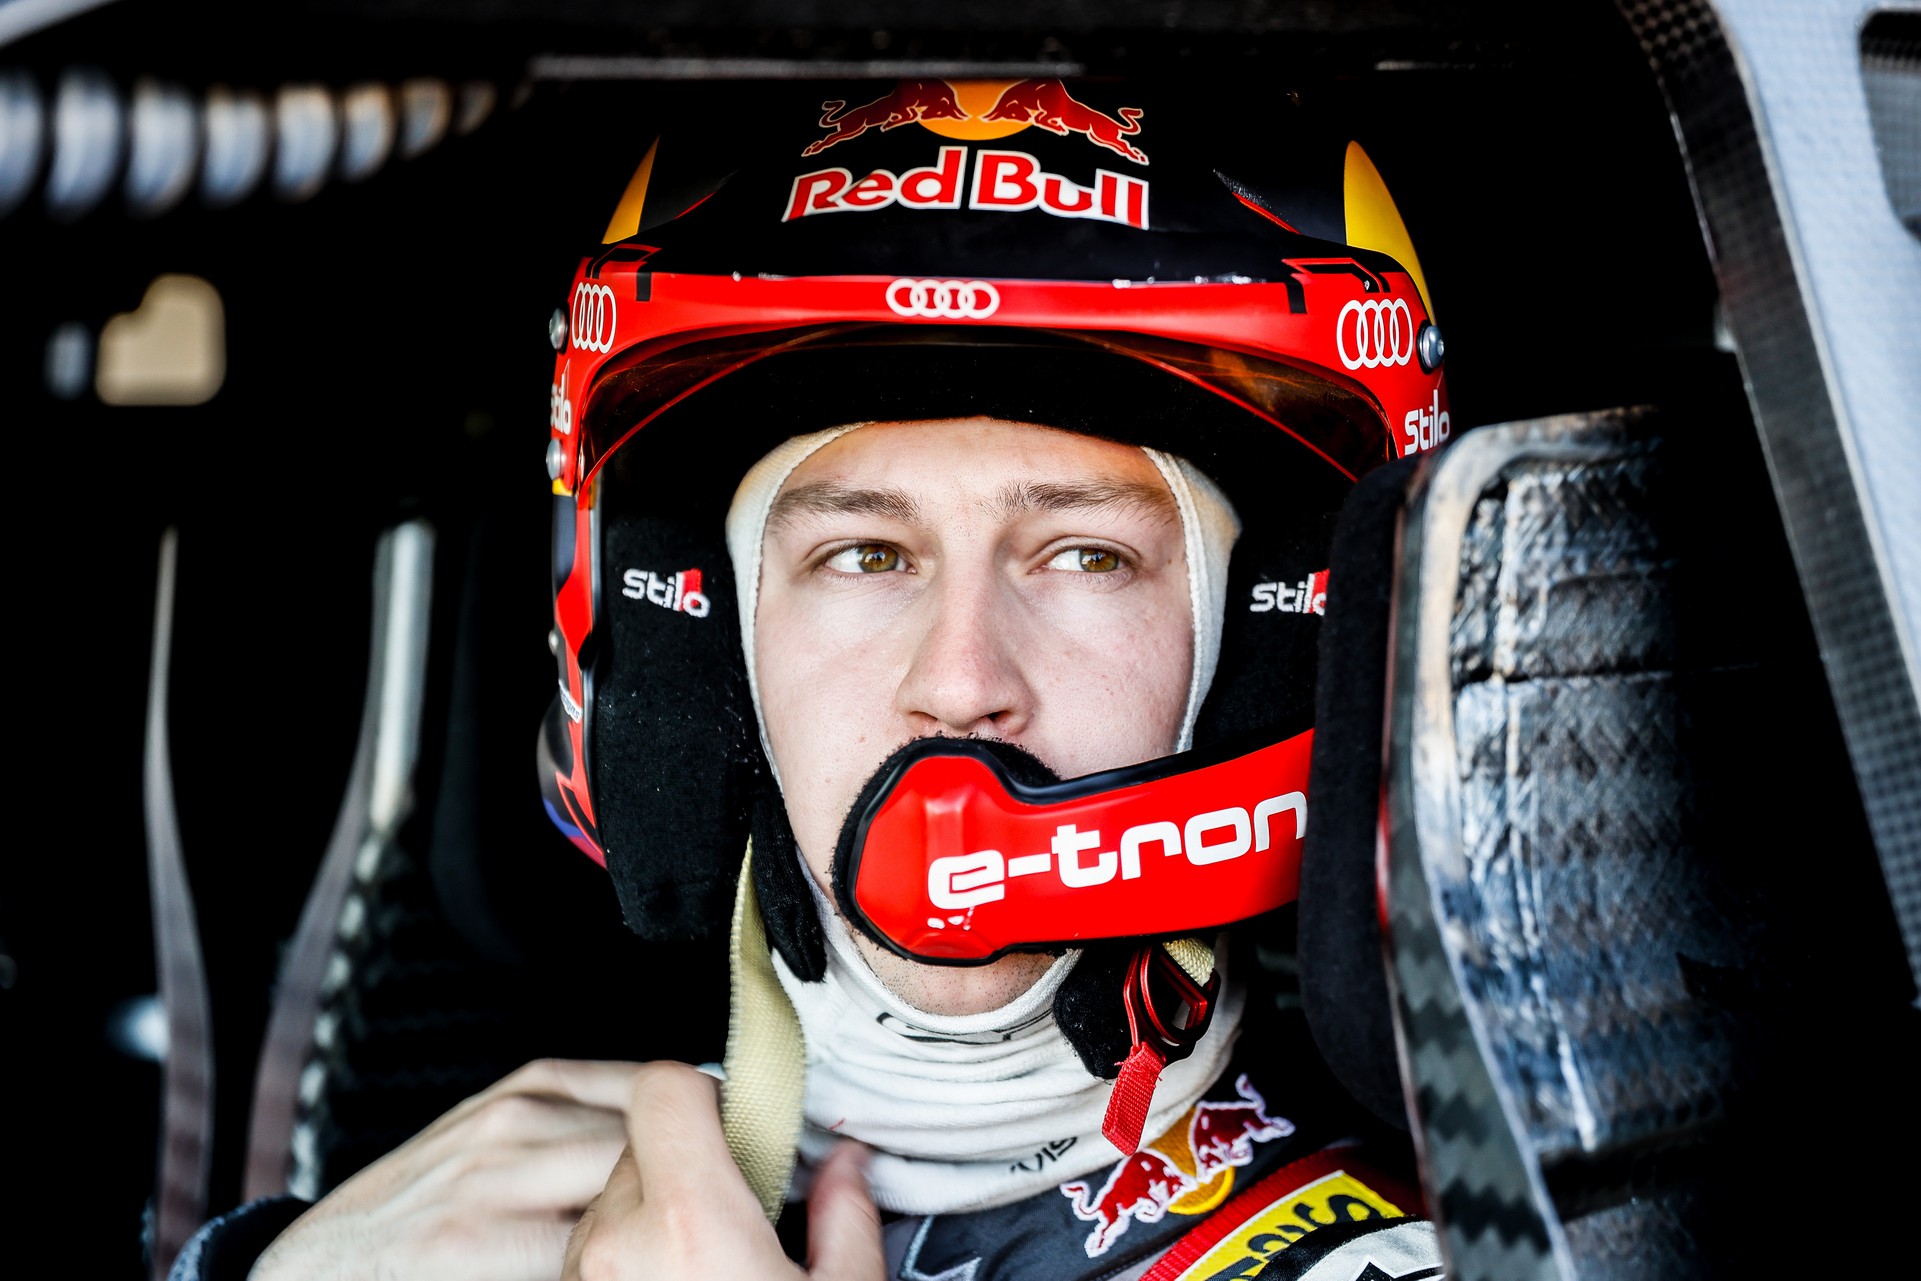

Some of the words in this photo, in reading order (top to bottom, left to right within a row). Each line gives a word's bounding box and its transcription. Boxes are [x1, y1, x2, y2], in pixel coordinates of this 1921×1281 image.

[781, 146, 967, 222] Red
[969, 150, 1149, 230] Bull
[1404, 389, 1450, 455] Stilo
[622, 567, 711, 618] Stilo
[928, 791, 1308, 910] e-tron
